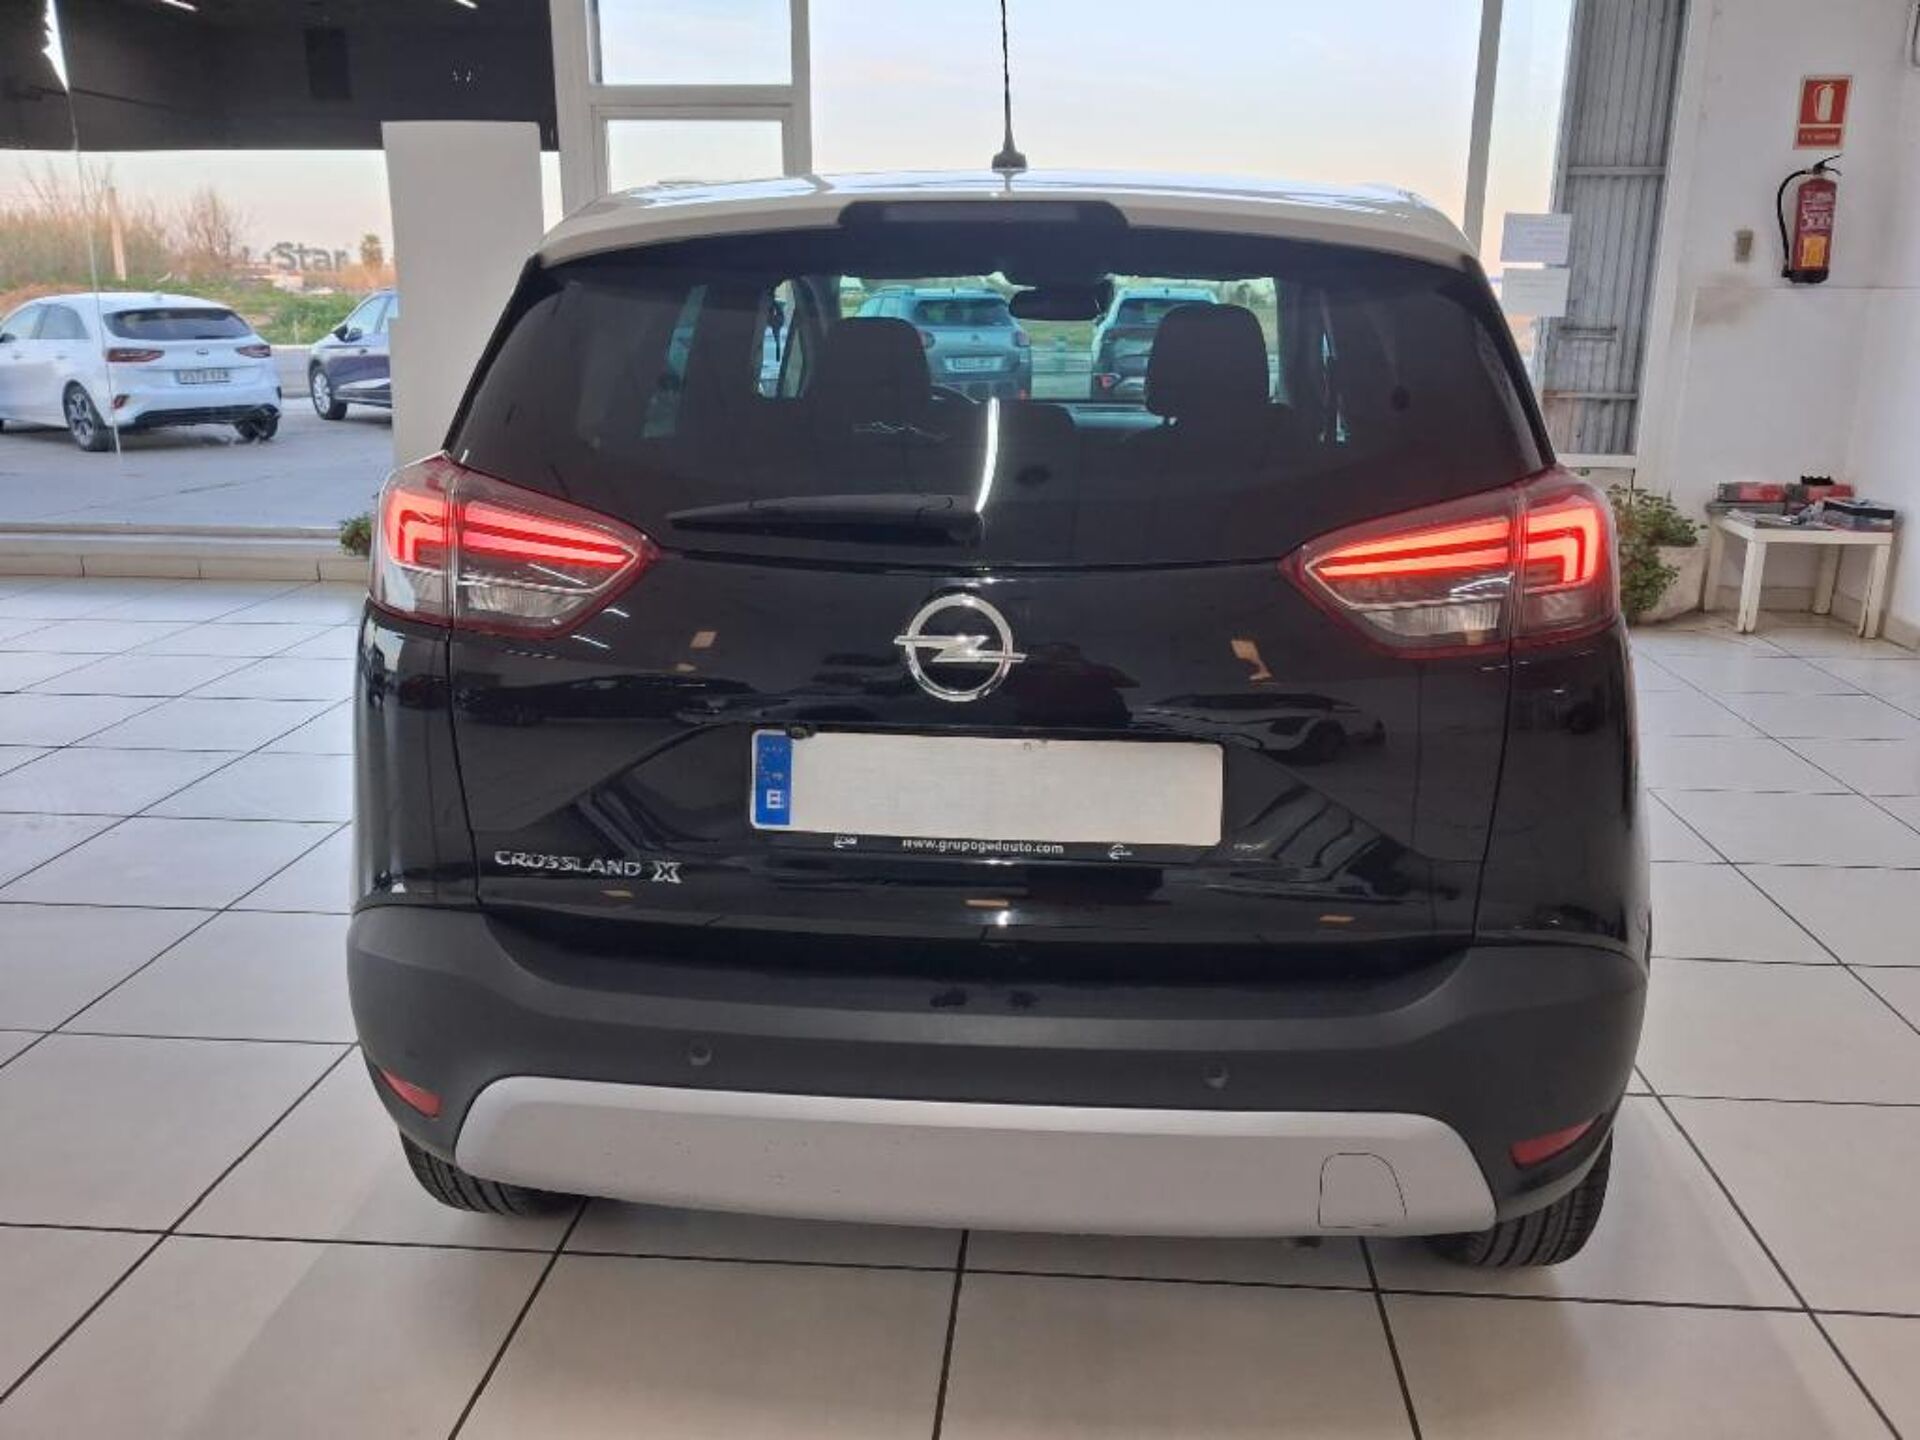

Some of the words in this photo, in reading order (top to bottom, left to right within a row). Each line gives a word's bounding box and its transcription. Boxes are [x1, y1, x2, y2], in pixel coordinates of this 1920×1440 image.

[274, 241, 347, 272] Star
[494, 850, 642, 877] CROSSLAND
[651, 860, 682, 884] X
